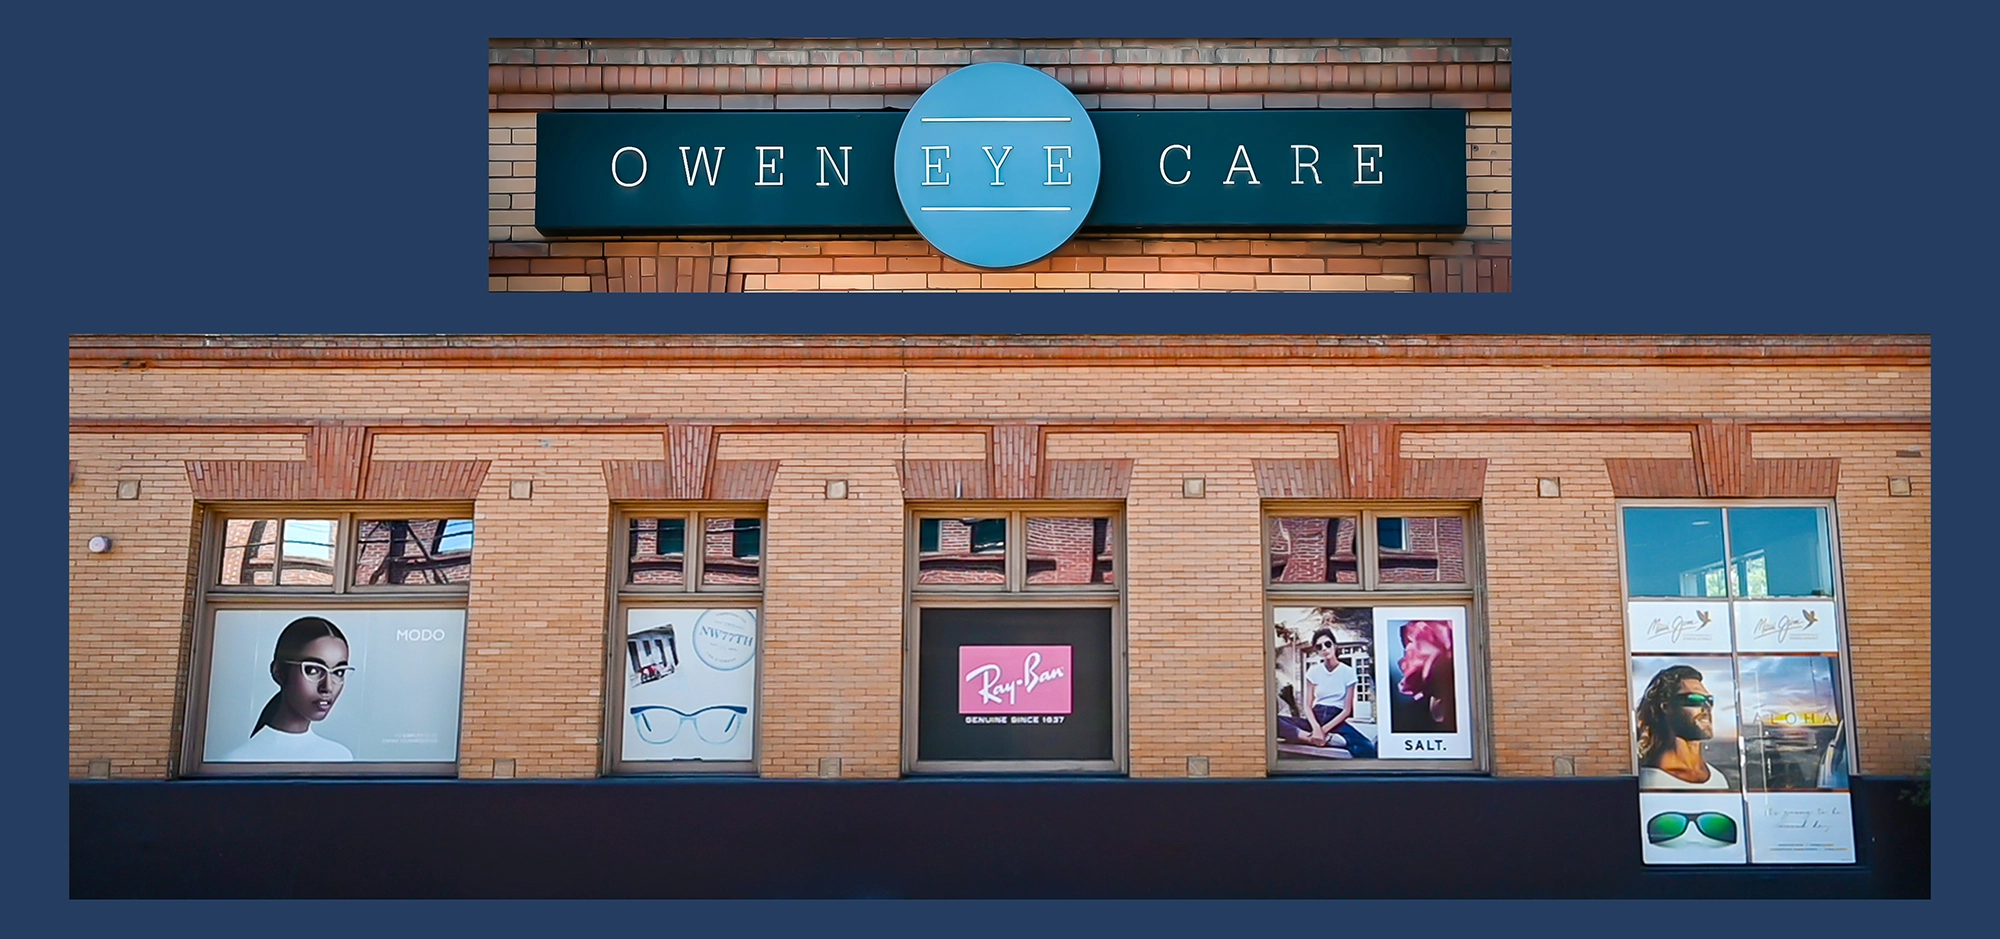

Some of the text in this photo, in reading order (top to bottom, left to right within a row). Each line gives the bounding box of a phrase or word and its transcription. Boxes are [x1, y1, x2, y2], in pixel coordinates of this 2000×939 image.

[611, 144, 1384, 188] OWEN EYE CARE
[396, 629, 445, 642] MODO
[699, 625, 754, 647] NW77TH
[965, 652, 1064, 705] Ray-Ban
[965, 716, 1007, 724] GENUINE
[1752, 712, 1834, 725] ALOHA
[1404, 739, 1447, 751] SALT.
